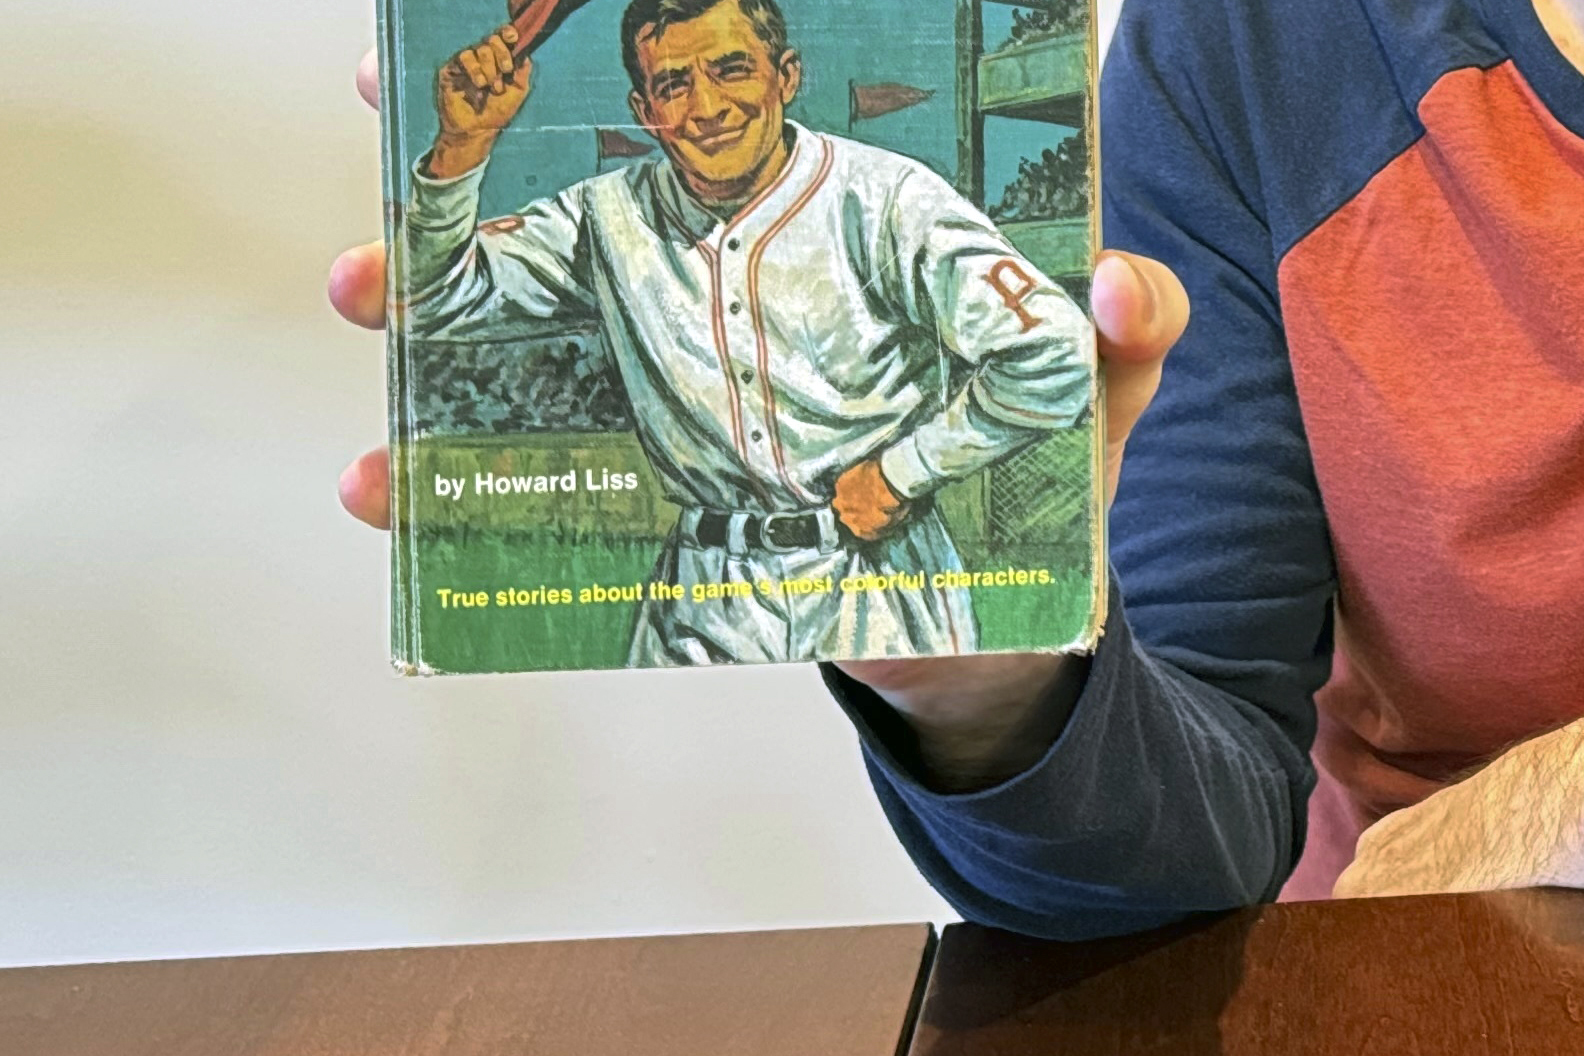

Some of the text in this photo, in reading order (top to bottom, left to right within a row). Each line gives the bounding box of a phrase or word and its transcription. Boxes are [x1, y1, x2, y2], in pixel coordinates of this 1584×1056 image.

[435, 467, 638, 501] by Howard Liss
[436, 588, 489, 609] True
[495, 585, 573, 607] stories
[579, 583, 643, 604] about
[649, 581, 685, 600] the
[780, 576, 832, 596] most
[840, 570, 925, 593] colorful
[932, 567, 1056, 589] characters.
